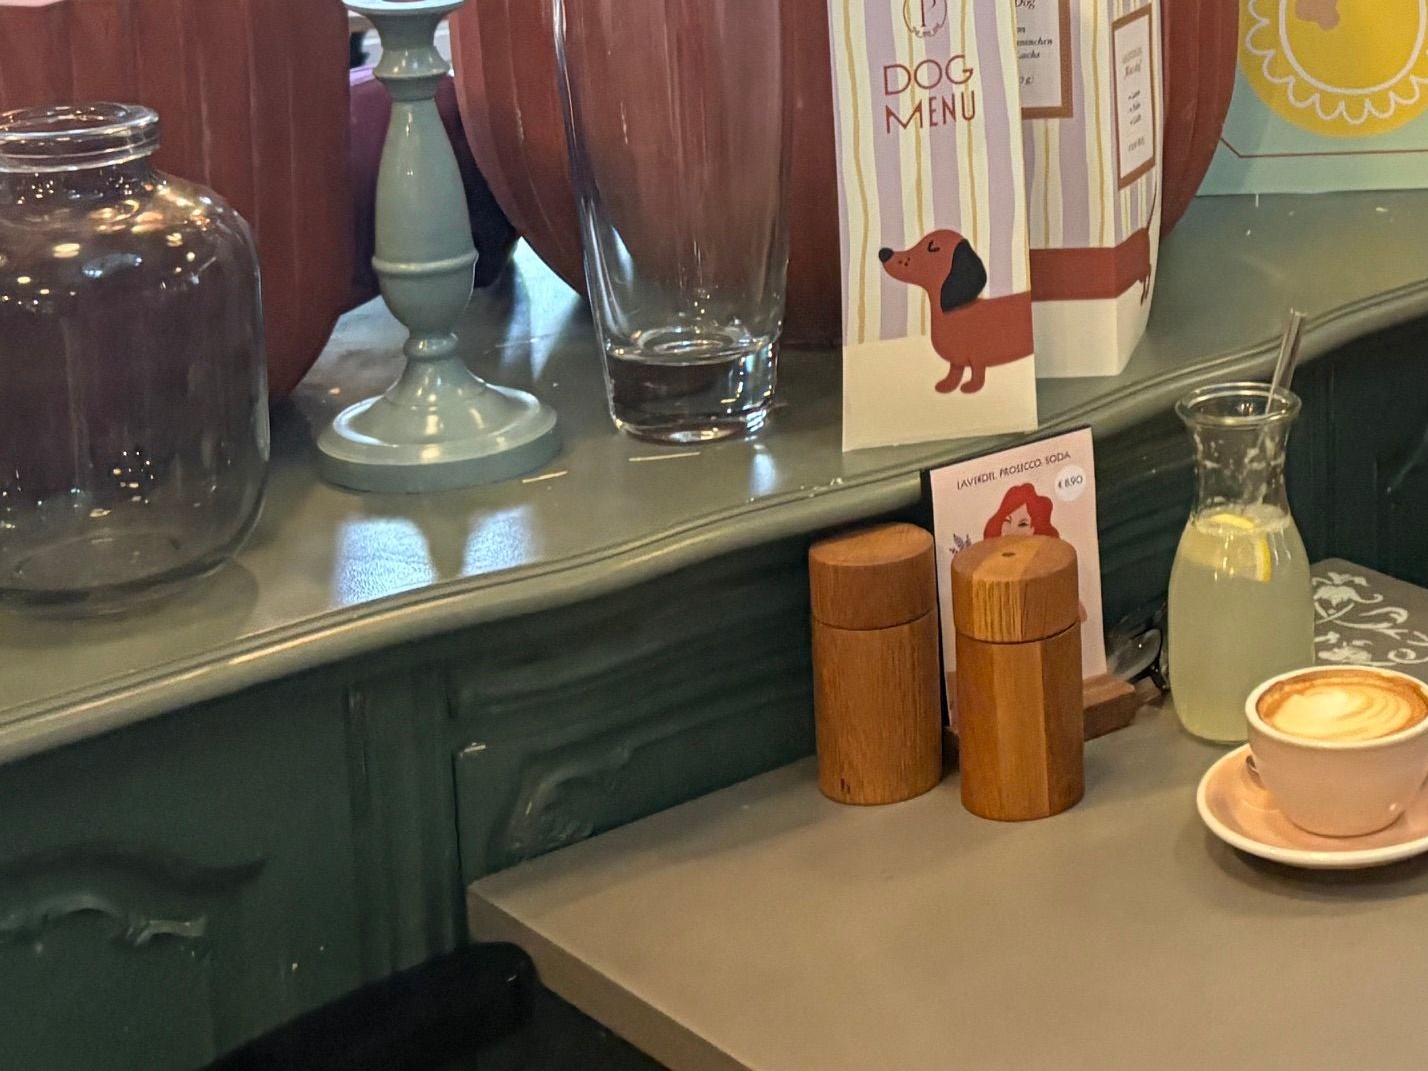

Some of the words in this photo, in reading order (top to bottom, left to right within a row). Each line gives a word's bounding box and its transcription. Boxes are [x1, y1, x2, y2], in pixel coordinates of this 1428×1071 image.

[883, 54, 974, 96] DOG
[884, 90, 976, 134] MENU
[1000, 459, 1042, 479] PROSECCO
[1045, 451, 1071, 465] SODA
